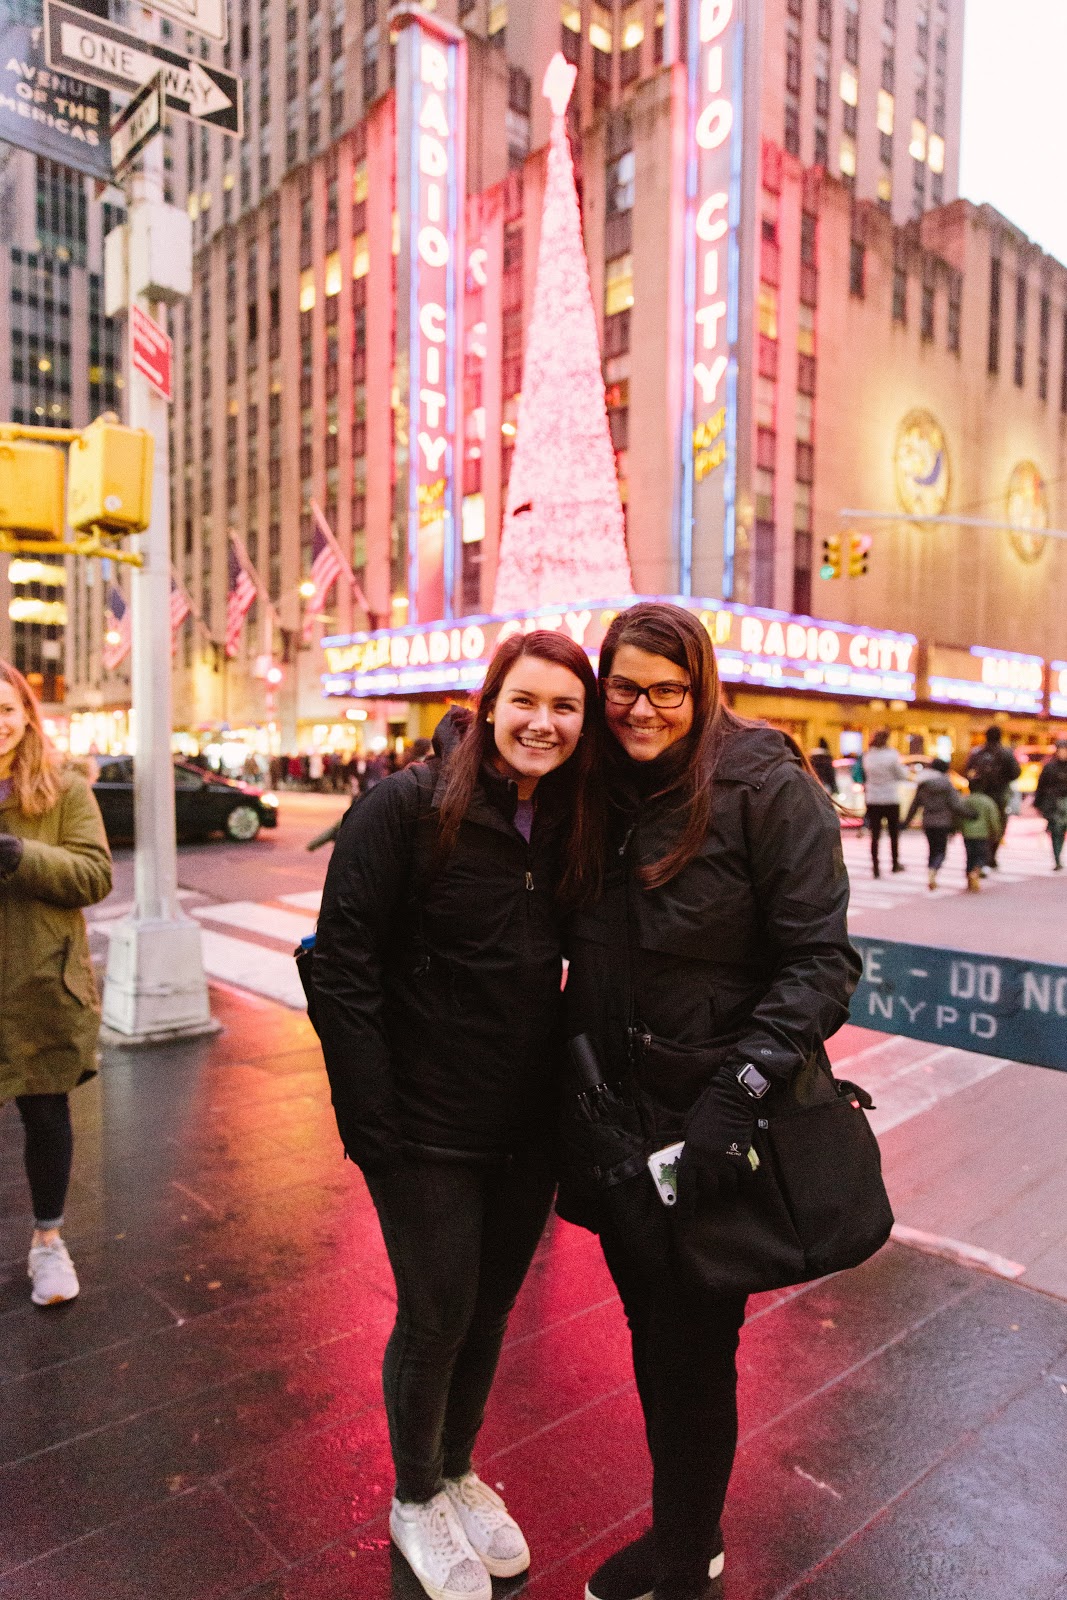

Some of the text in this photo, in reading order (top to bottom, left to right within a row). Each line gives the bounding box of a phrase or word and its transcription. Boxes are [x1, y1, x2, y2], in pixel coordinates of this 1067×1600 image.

[80, 34, 134, 77] ONE
[163, 70, 213, 106] WAY
[54, 96, 99, 125] THE
[418, 43, 449, 267] RADIO
[693, 192, 729, 403] CITY
[418, 302, 447, 472] CITY
[391, 625, 485, 667] RADIO
[741, 617, 840, 664] RADIO
[849, 635, 913, 673] CITY
[950, 961, 1001, 1005] DO
[868, 991, 999, 1039] NYPD
